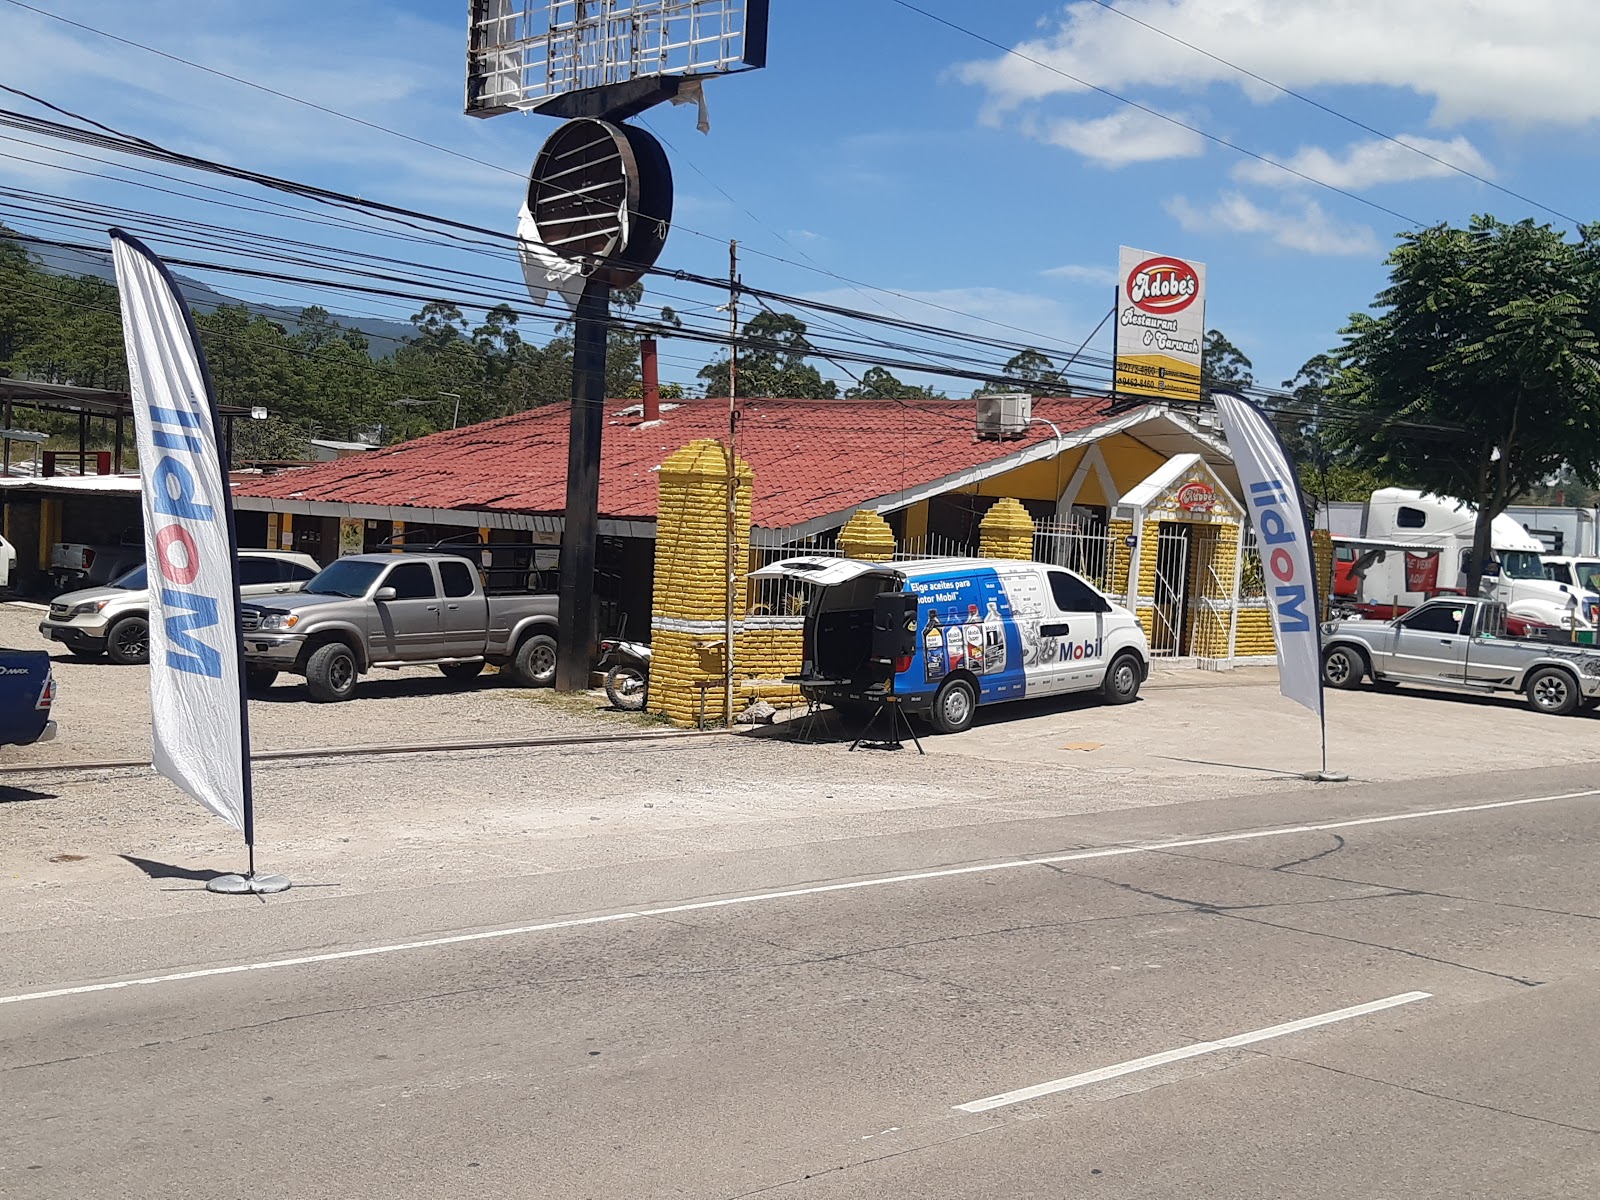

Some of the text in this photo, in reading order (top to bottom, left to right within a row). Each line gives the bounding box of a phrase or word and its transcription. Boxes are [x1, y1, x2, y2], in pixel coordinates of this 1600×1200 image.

[1131, 271, 1196, 303] Adobe's
[1121, 307, 1178, 333] Restaurant
[1143, 331, 1199, 354] & Carwash
[910, 580, 971, 593] Elige aceites para
[1059, 637, 1103, 662] Mobil
